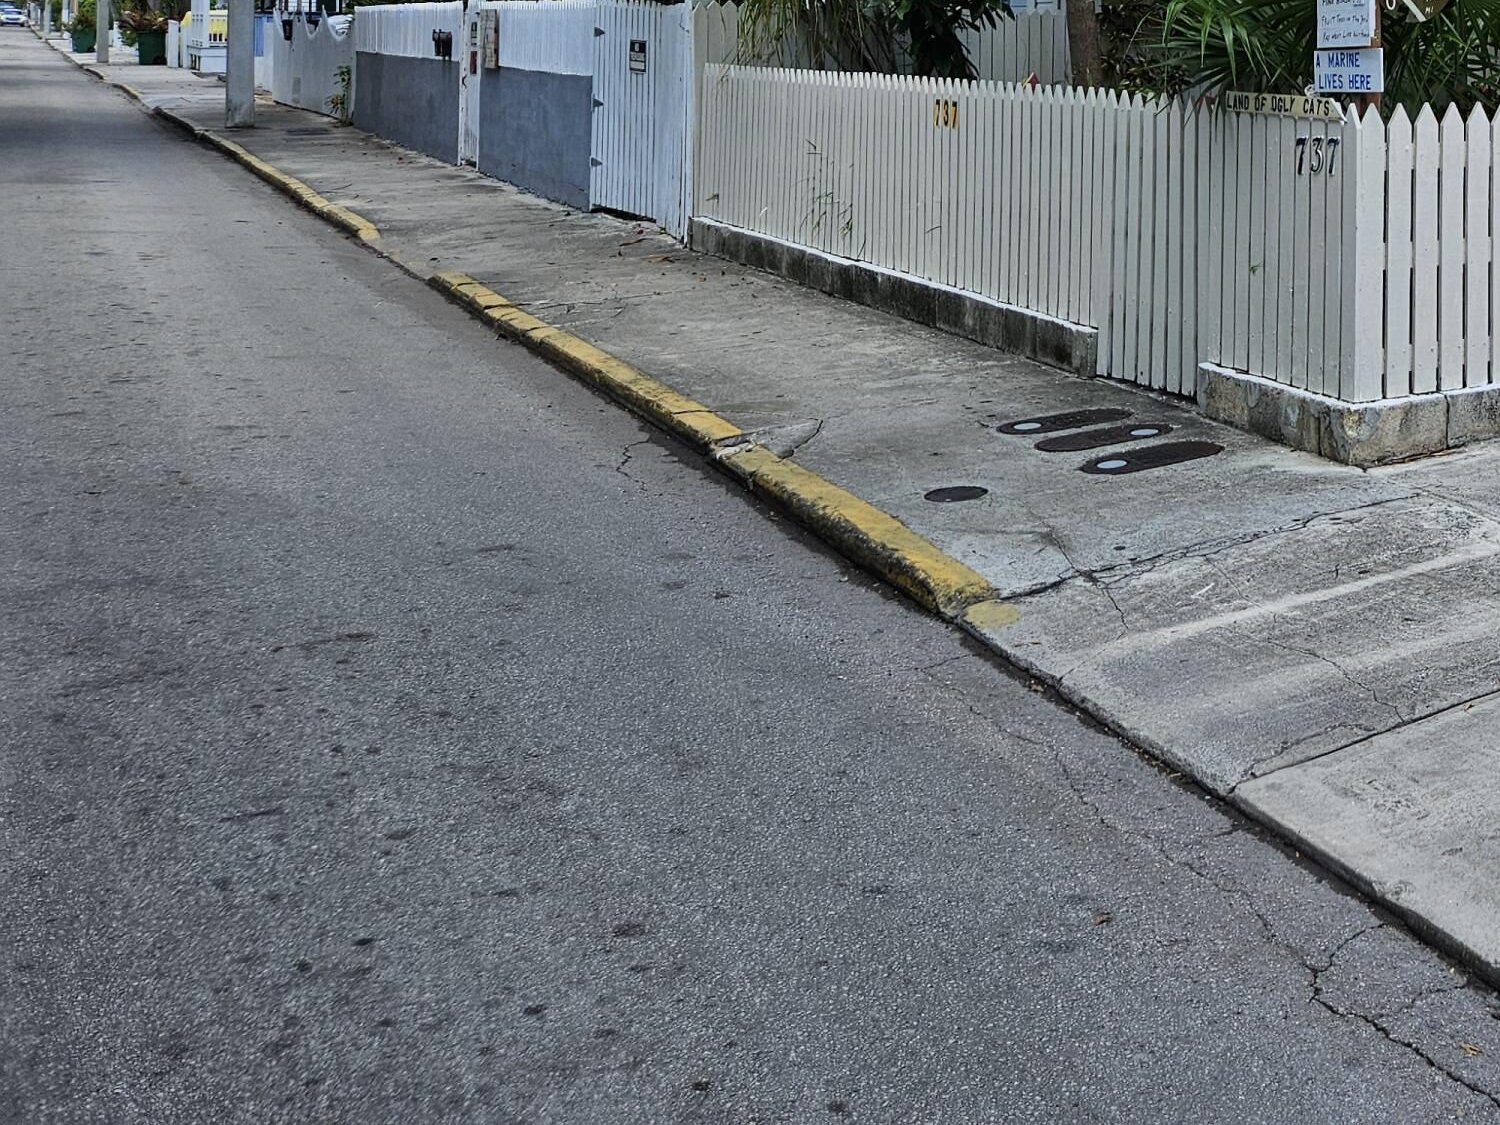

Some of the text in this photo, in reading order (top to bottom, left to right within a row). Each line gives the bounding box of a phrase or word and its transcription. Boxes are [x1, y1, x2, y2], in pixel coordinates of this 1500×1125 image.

[1315, 52, 1361, 69] A MARINE
[1318, 74, 1372, 90] LIVES HERE
[934, 98, 959, 129] 737
[1226, 93, 1330, 116] LAND OF UGLY CATS
[1295, 136, 1341, 175] 737
